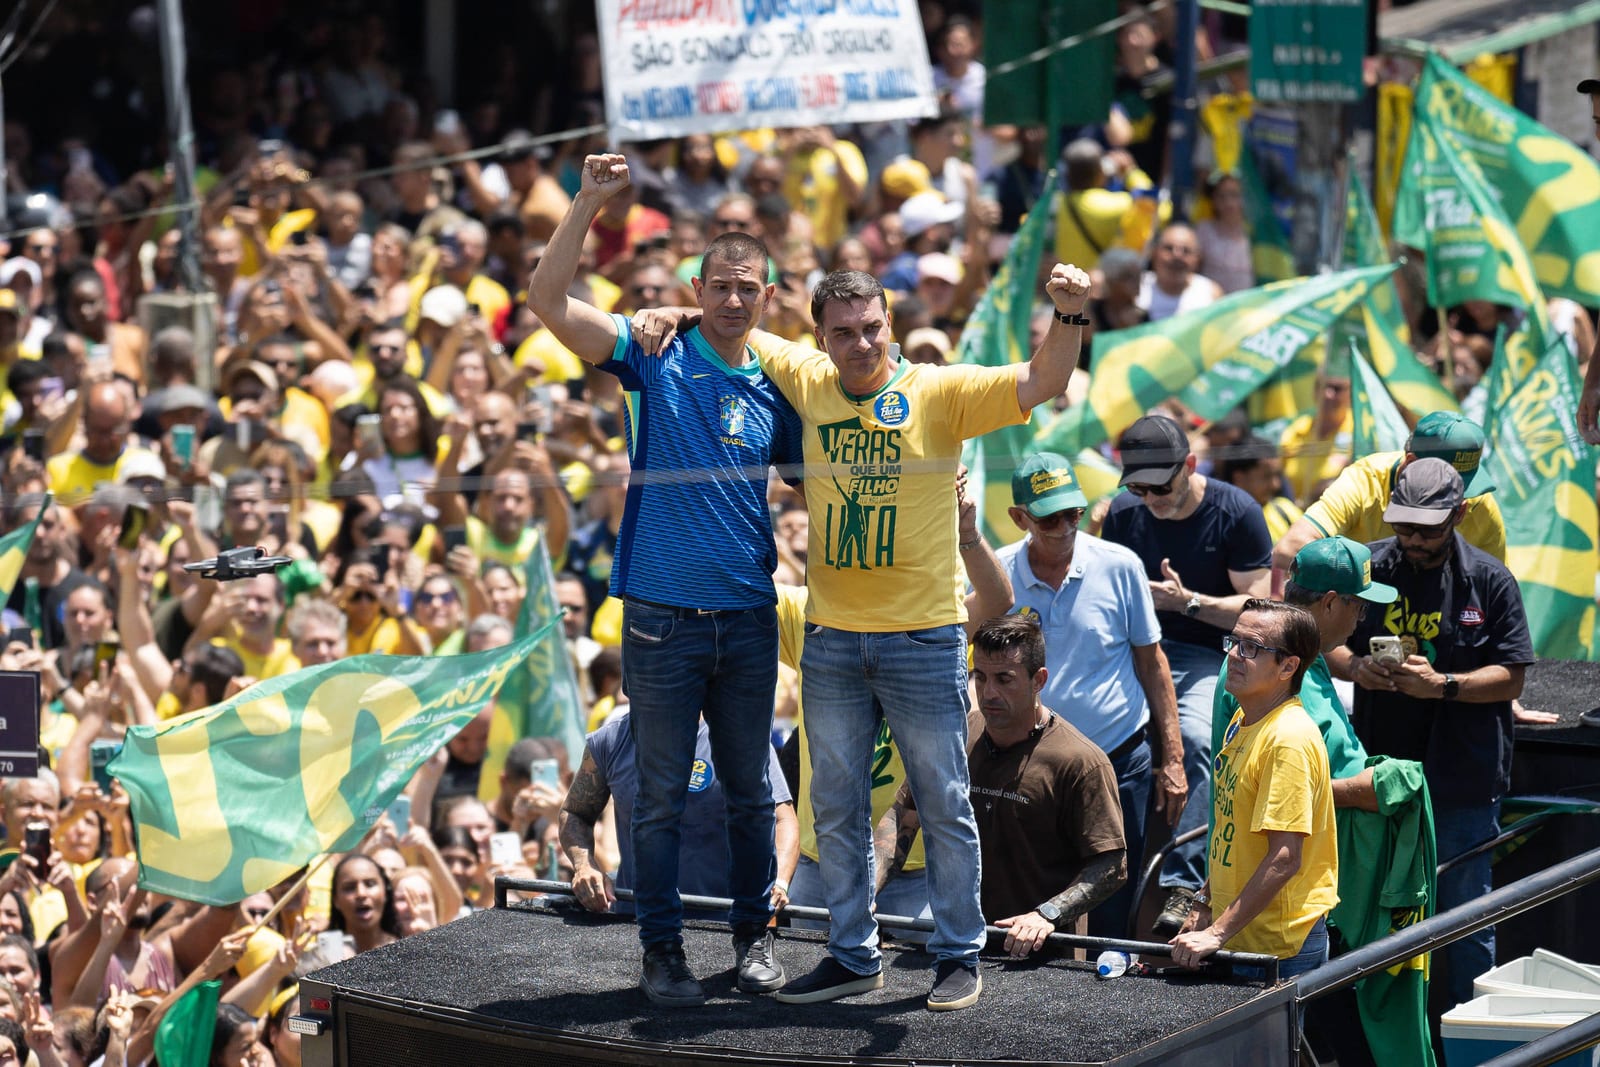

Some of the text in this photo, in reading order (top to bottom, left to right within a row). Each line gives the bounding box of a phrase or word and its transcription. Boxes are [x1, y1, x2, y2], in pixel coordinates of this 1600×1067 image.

[882, 394, 900, 406] 22
[719, 436, 746, 447] BRASIL
[828, 424, 902, 465] VERÁS
[850, 464, 902, 476] QUE UM
[848, 478, 898, 494] FILHO
[692, 760, 707, 774] 22
[981, 787, 1003, 797] coastal
[1003, 790, 1030, 804] culture
